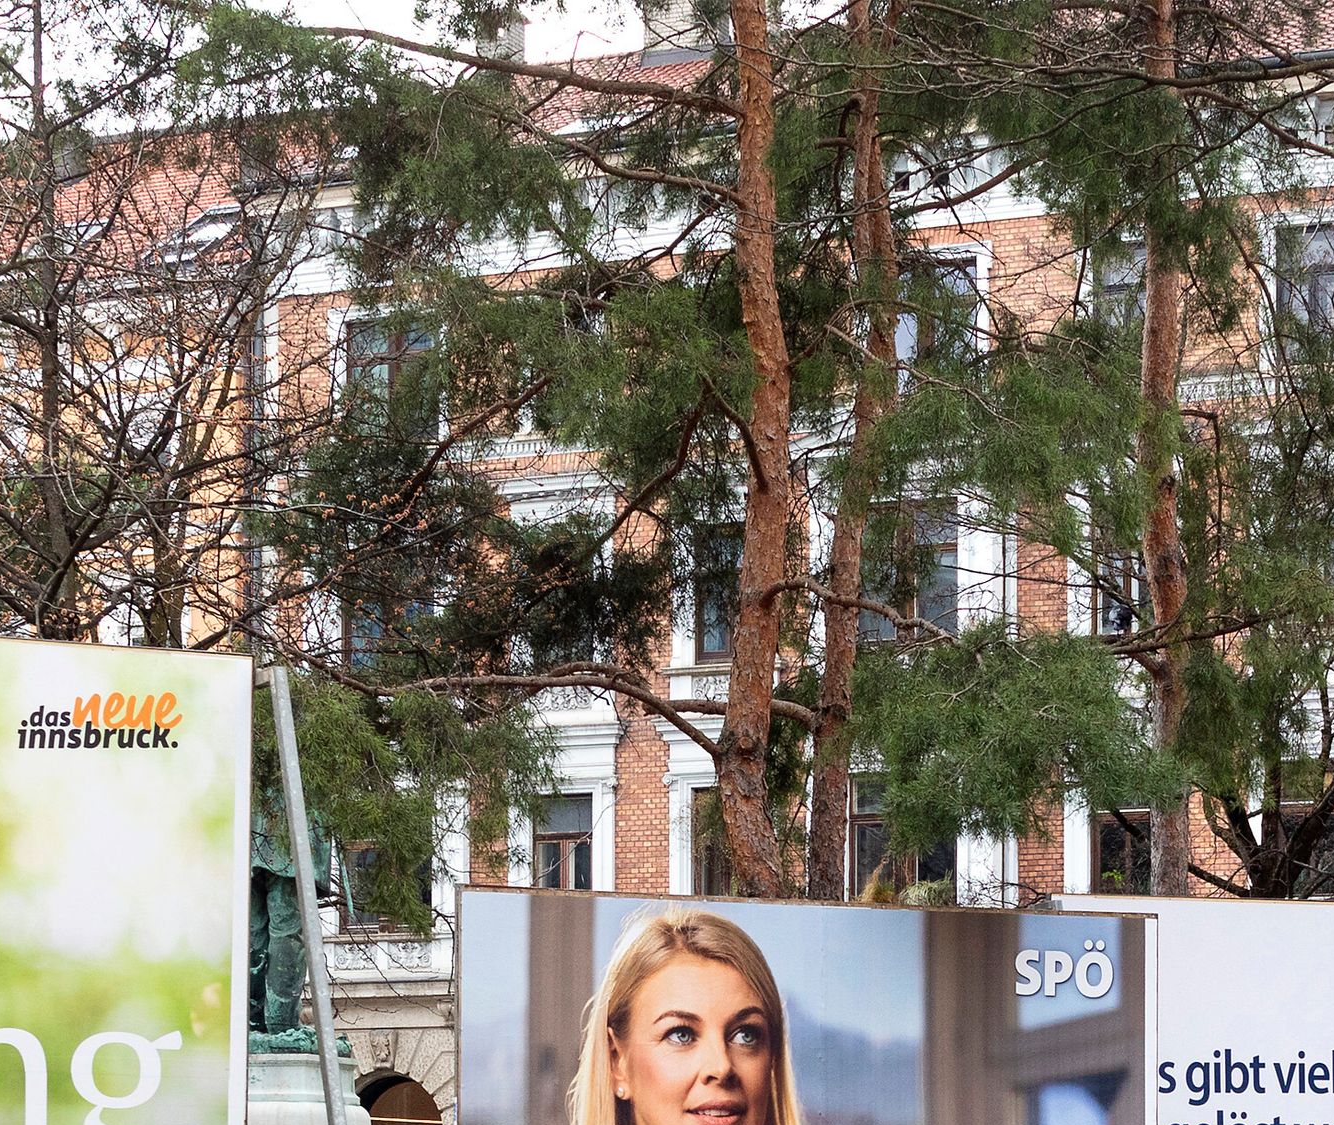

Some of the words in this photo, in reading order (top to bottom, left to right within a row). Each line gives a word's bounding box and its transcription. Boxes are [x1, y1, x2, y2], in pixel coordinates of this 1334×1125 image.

[17, 720, 179, 749] innsbruck.
[72, 691, 183, 730] neue
[1014, 938, 1114, 999] SPÖ
[1157, 1060, 1177, 1094] s
[1185, 1049, 1266, 1107] gibt
